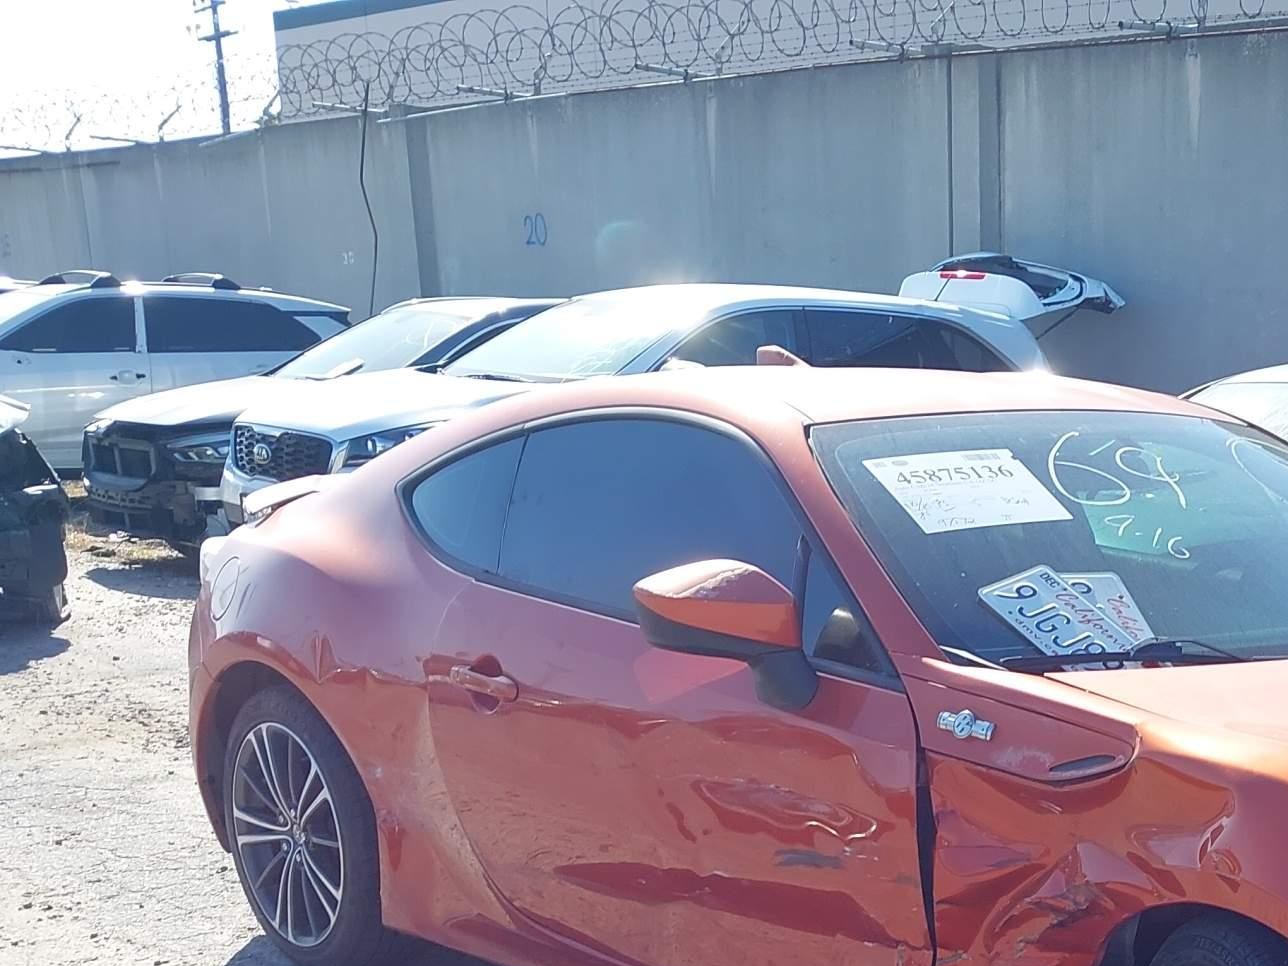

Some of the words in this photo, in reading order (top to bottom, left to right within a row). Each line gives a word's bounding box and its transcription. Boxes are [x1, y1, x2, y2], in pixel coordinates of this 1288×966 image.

[523, 211, 548, 247] 20
[896, 464, 1014, 485] 45875136
[1039, 572, 1061, 589] DEC
